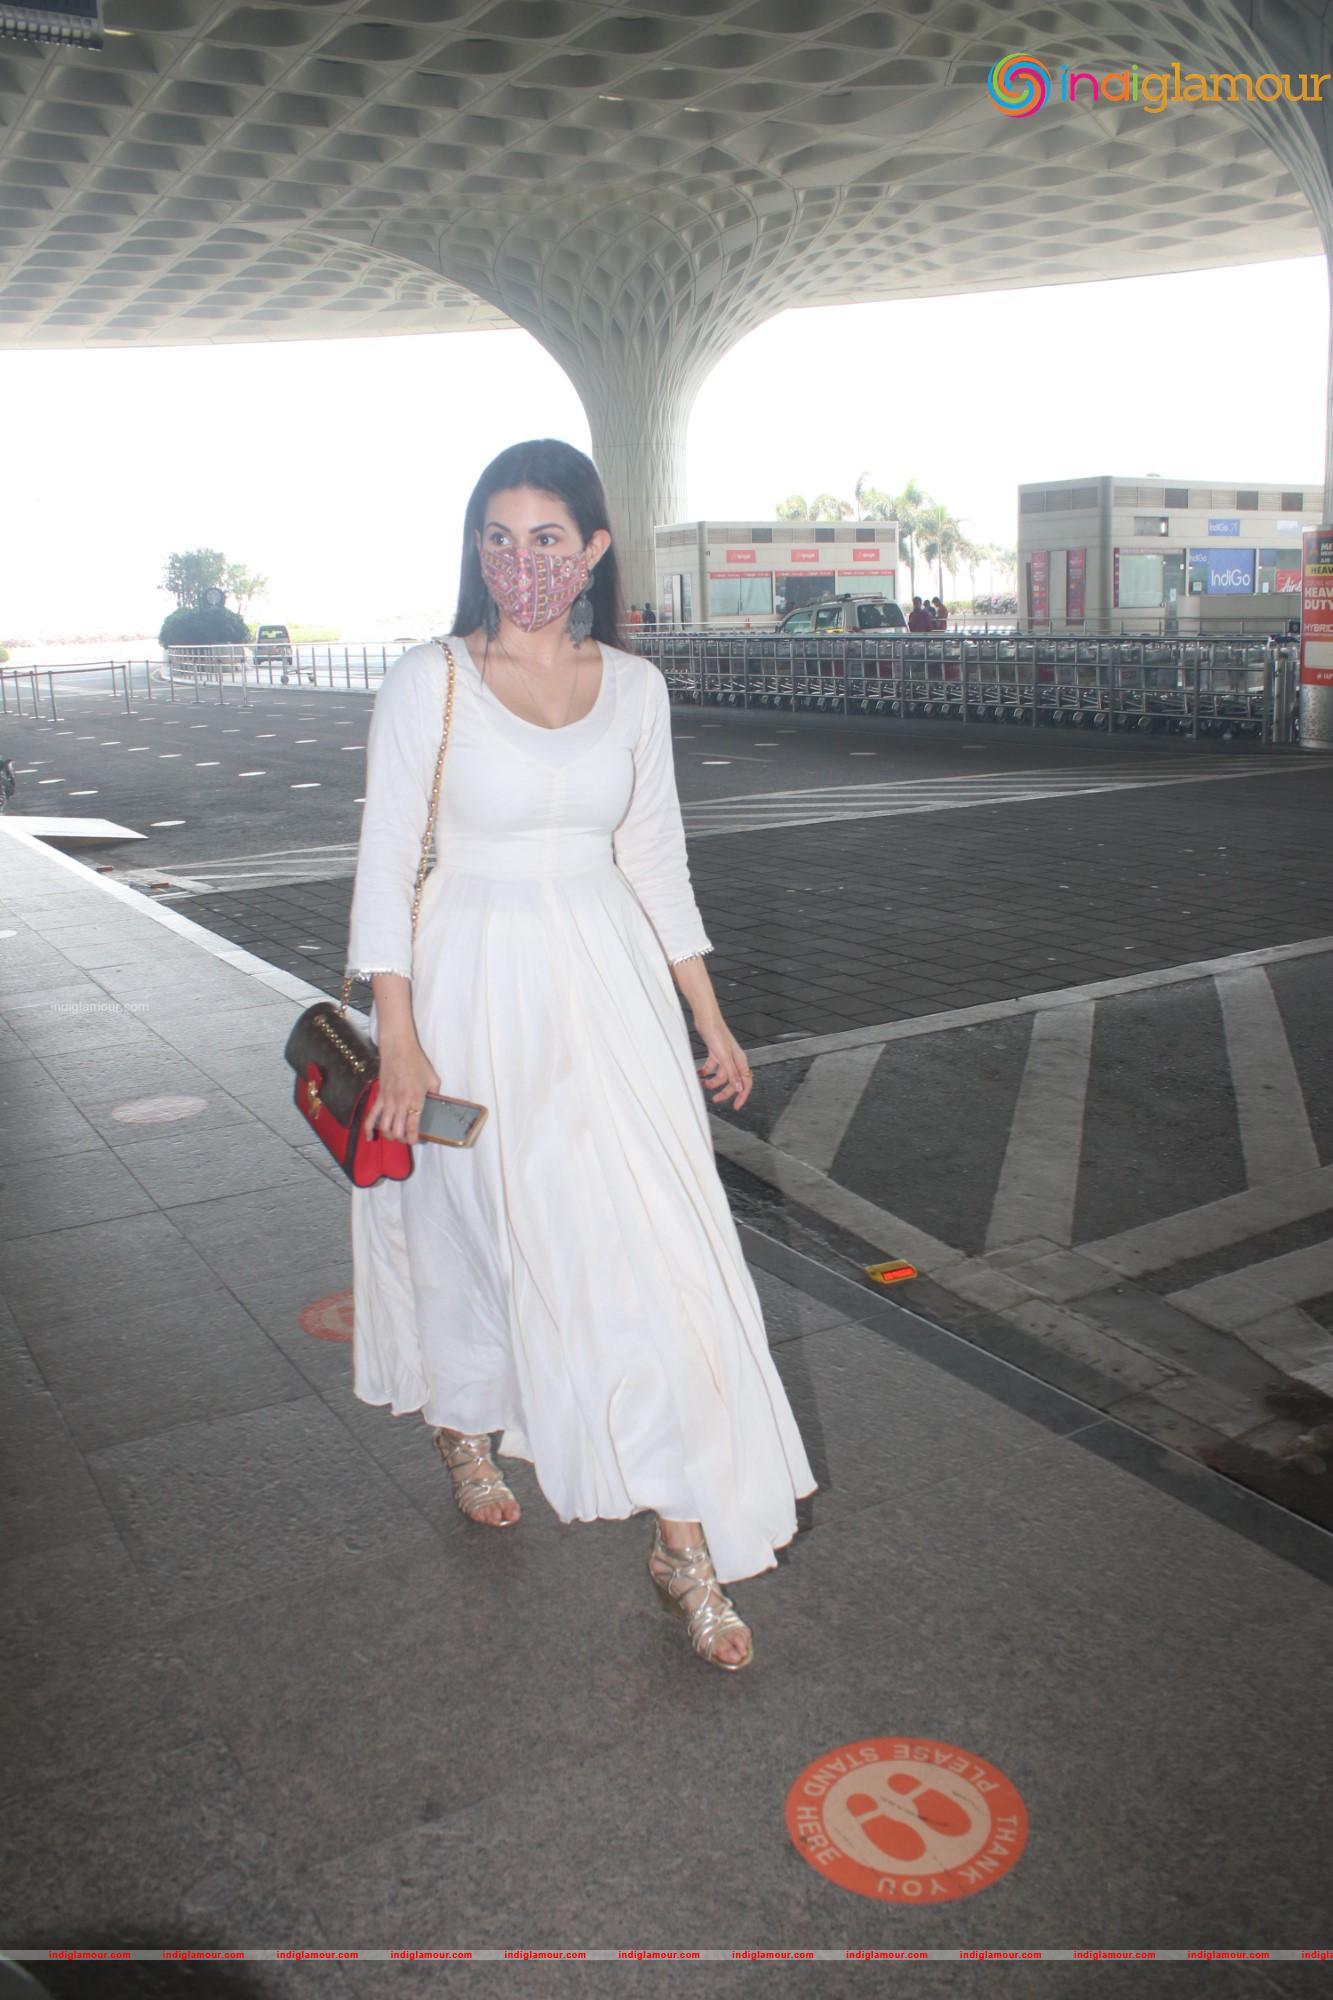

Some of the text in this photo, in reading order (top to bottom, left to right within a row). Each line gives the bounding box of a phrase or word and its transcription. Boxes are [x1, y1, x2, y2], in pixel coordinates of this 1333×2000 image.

[1211, 569, 1251, 586] IndiGo
[796, 1743, 1000, 1866] PLEASE STAND HERE
[876, 1815, 1018, 1897] THANK YOU
